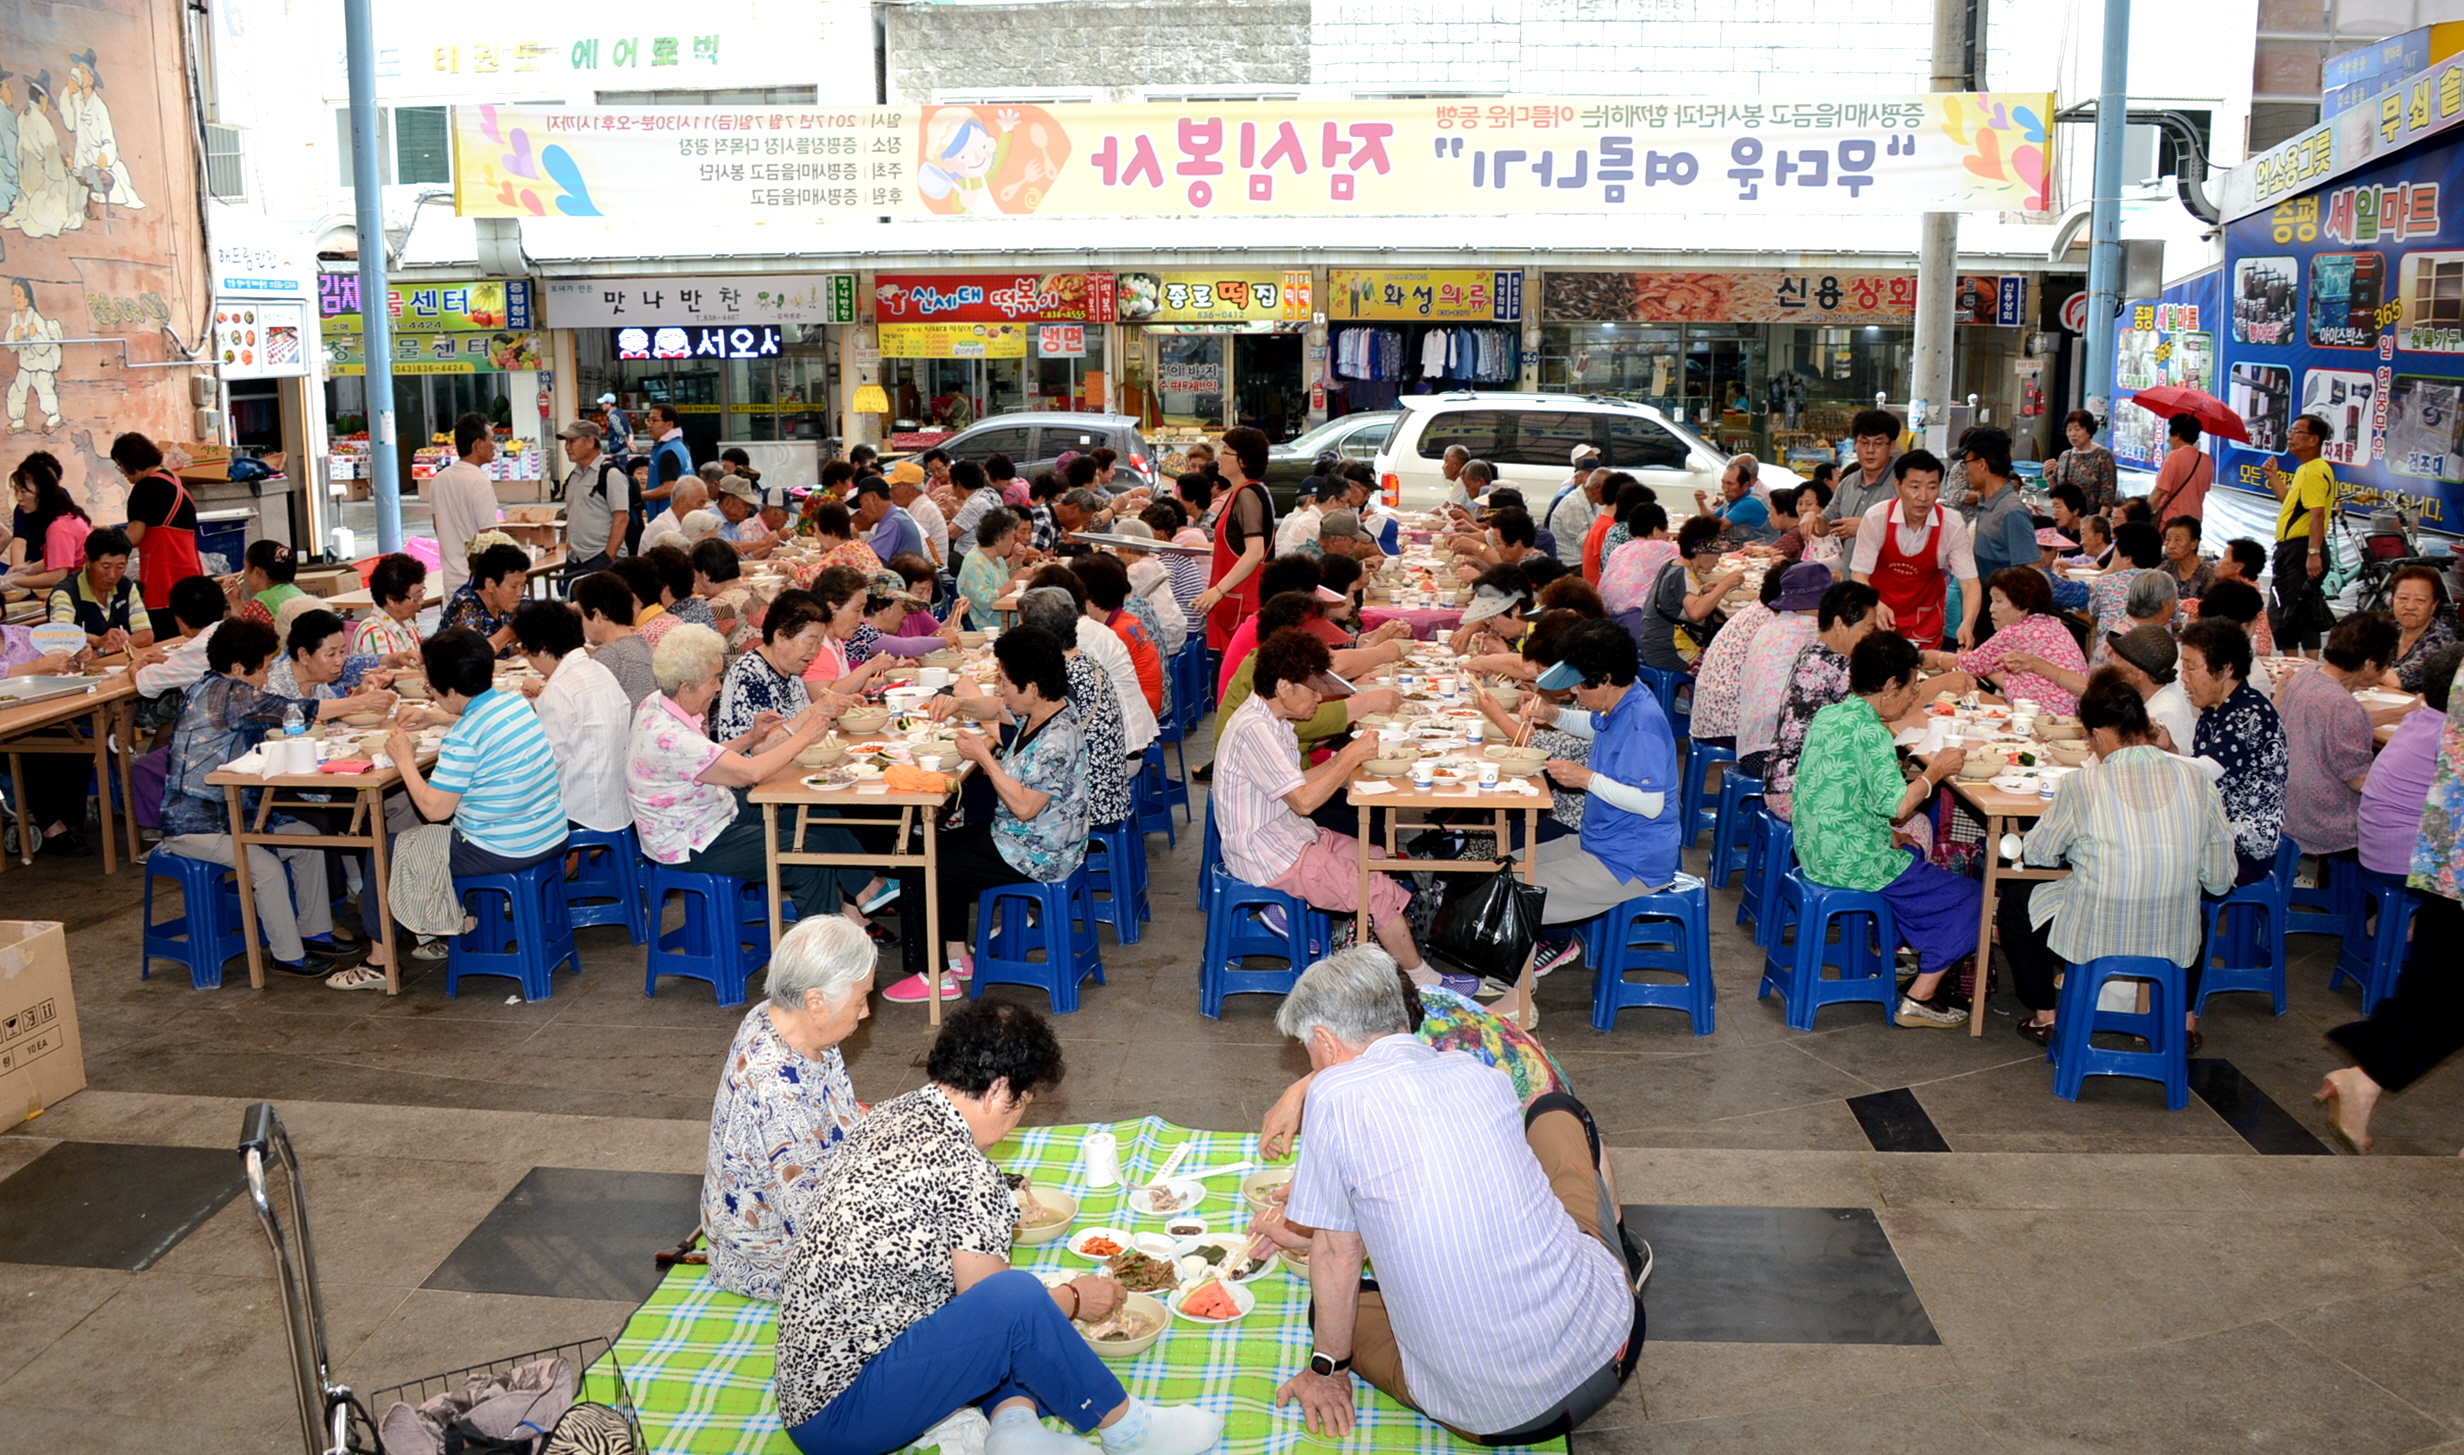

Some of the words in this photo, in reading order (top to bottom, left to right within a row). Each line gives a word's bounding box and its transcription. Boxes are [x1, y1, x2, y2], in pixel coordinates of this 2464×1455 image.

[2255, 128, 2331, 203] 업소용그릇
[2271, 195, 2320, 243] 증평
[2325, 184, 2439, 243] 세일마트
[509, 282, 526, 328] 증평청과
[911, 286, 983, 315] 신세대
[990, 277, 1058, 318] 떡볶이
[1384, 283, 1485, 315] 화성의류
[2003, 283, 2014, 320] 신용상회
[1197, 311, 1245, 319] 836-0412
[2134, 305, 2155, 331] 증평
[2156, 303, 2199, 332] 세일마트
[2373, 297, 2403, 331] 365
[1041, 326, 1084, 354] 냉면
[2249, 323, 2277, 344] 항아리
[2319, 326, 2366, 346] 아이스박스
[2378, 336, 2394, 360] 일
[2154, 340, 2172, 364] 365
[2372, 365, 2393, 461] 연중무휴
[2240, 464, 2262, 487] 모든
[2407, 453, 2444, 478] 건조대
